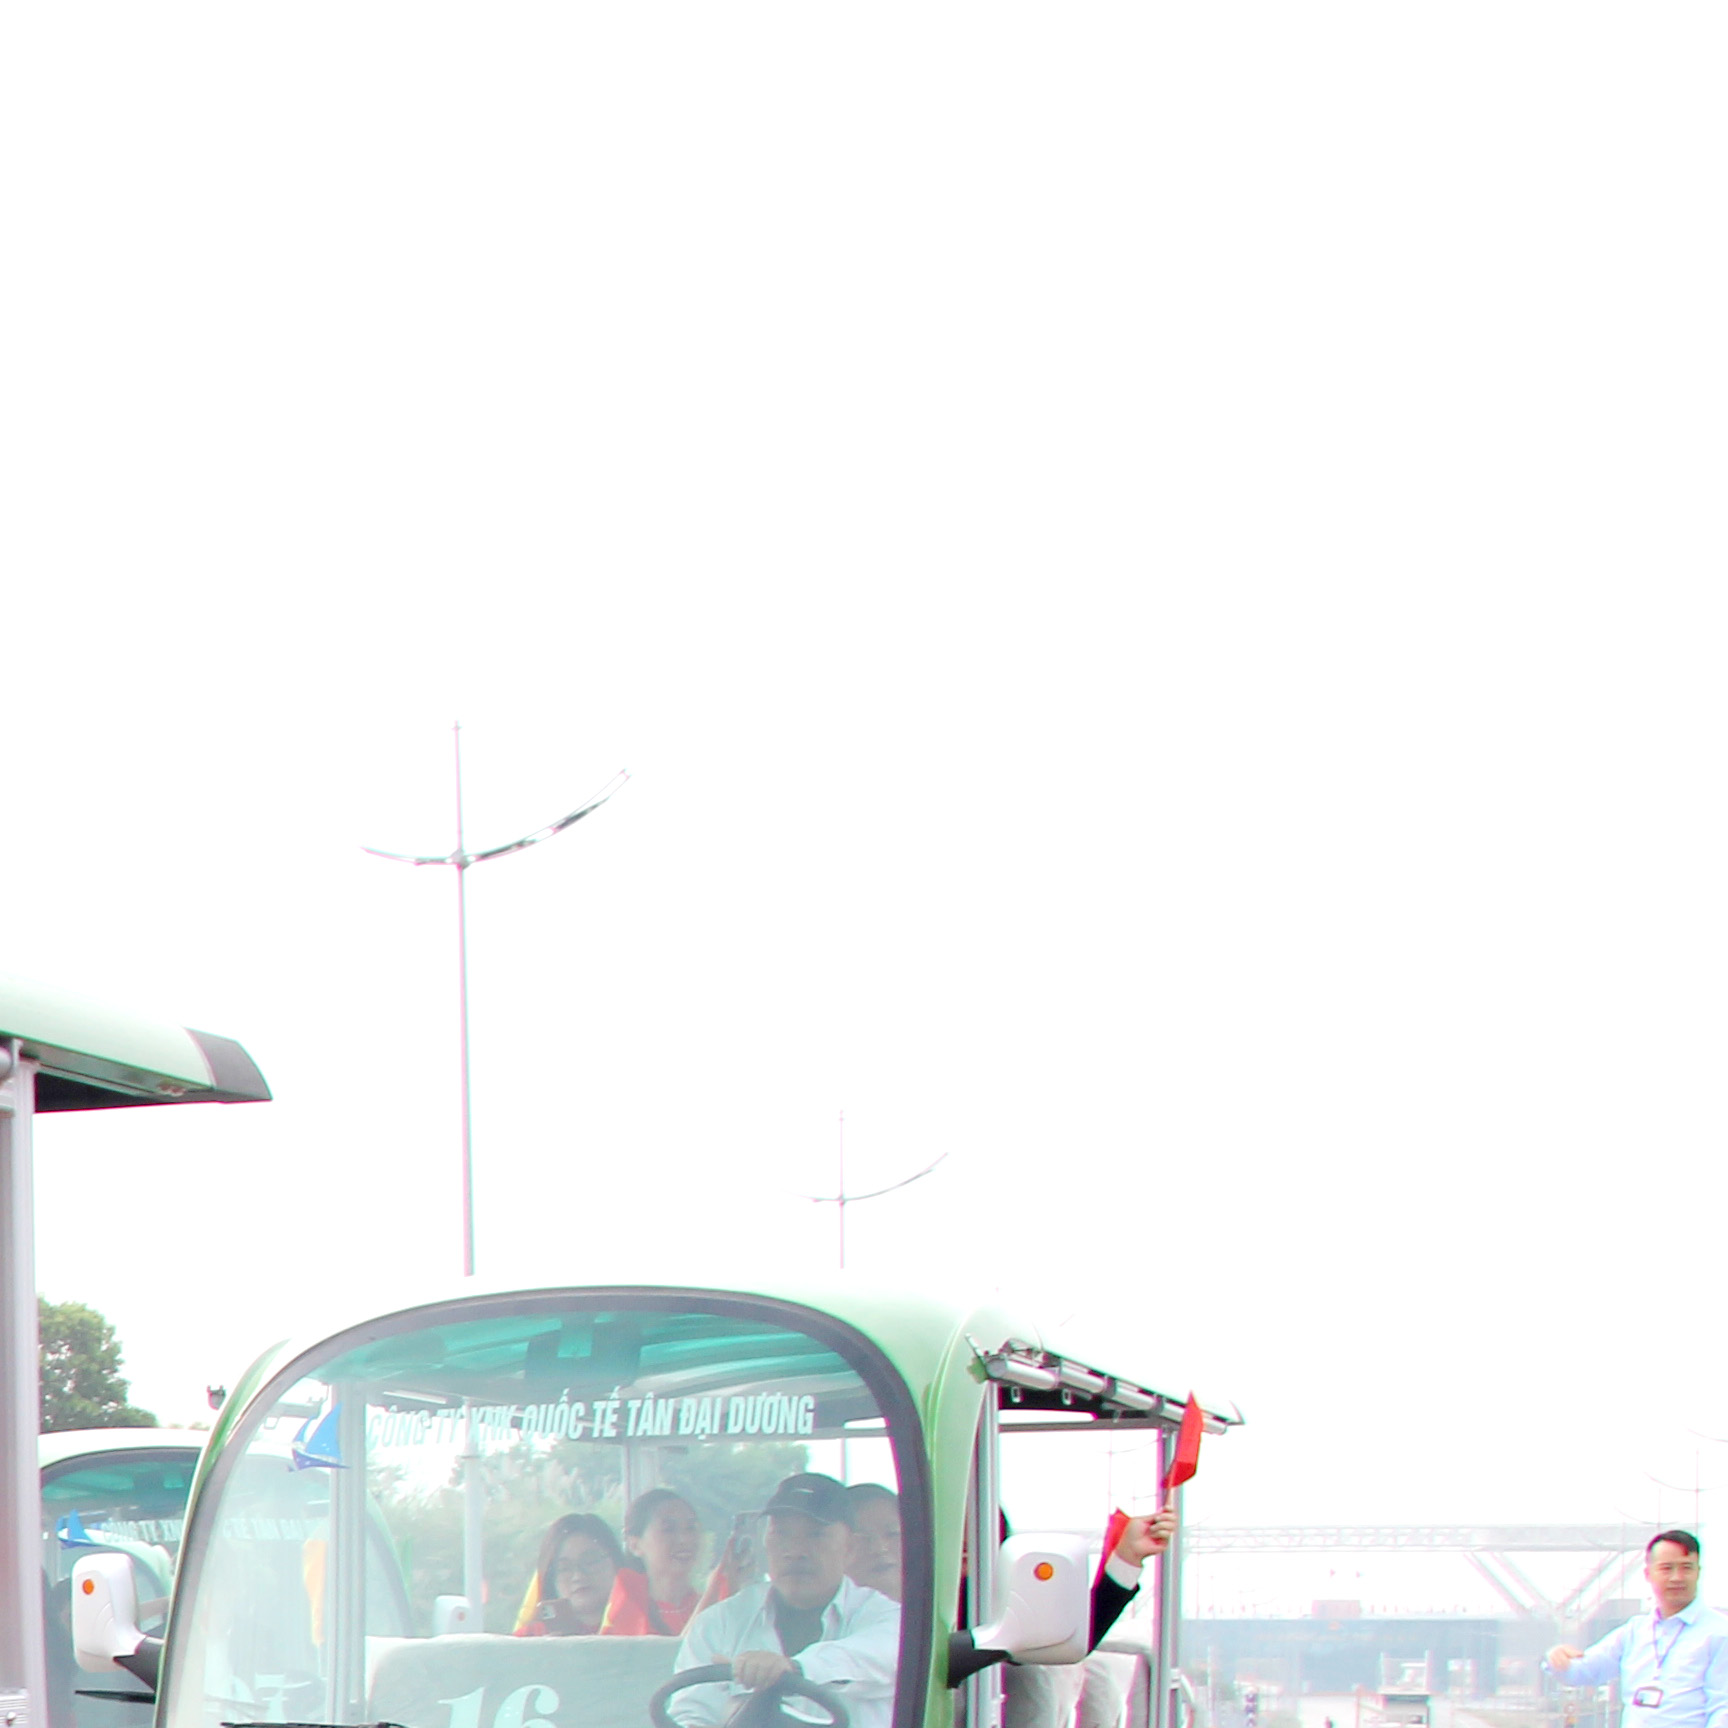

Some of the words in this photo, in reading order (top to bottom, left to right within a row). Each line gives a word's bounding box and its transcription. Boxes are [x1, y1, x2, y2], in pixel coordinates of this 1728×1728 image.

[522, 1387, 585, 1441] QUỐC
[592, 1385, 620, 1438] TẾ
[626, 1392, 675, 1436] TÂN
[678, 1396, 722, 1440] ĐẠI
[726, 1394, 815, 1435] DƯƠNG
